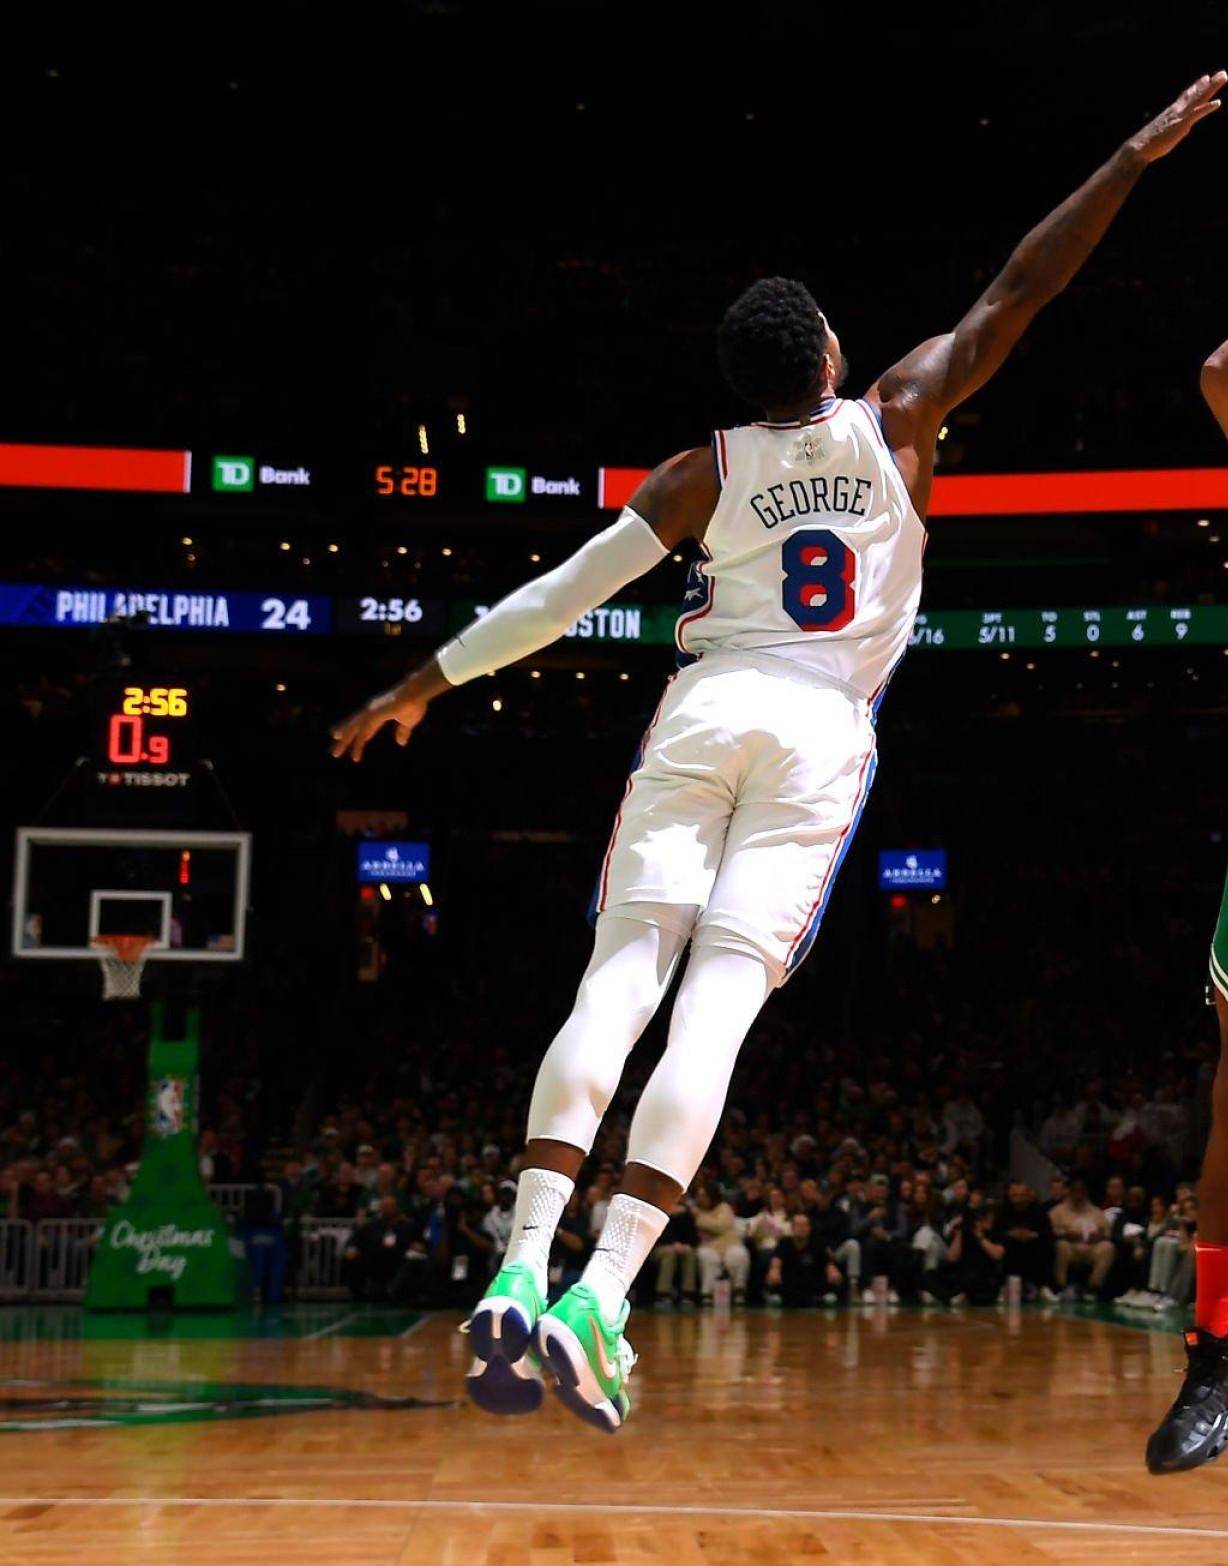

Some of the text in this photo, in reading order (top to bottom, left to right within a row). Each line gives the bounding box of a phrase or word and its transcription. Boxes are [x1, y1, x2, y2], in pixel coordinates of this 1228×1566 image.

[217, 461, 310, 486] TD Bank
[490, 473, 580, 497] TD Bank
[750, 476, 872, 529] GEORGE
[782, 529, 856, 632] 8
[56, 590, 311, 631] PHILADELPHIA 24
[360, 597, 423, 622] 2:56
[564, 608, 642, 639] STON
[1044, 625, 1057, 643] 5
[1086, 624, 1100, 642] 0
[1131, 624, 1145, 641] 6
[1175, 622, 1189, 640] 9
[123, 687, 188, 716] 2:56
[109, 714, 169, 764] 0.9
[136, 1244, 187, 1280] Day
